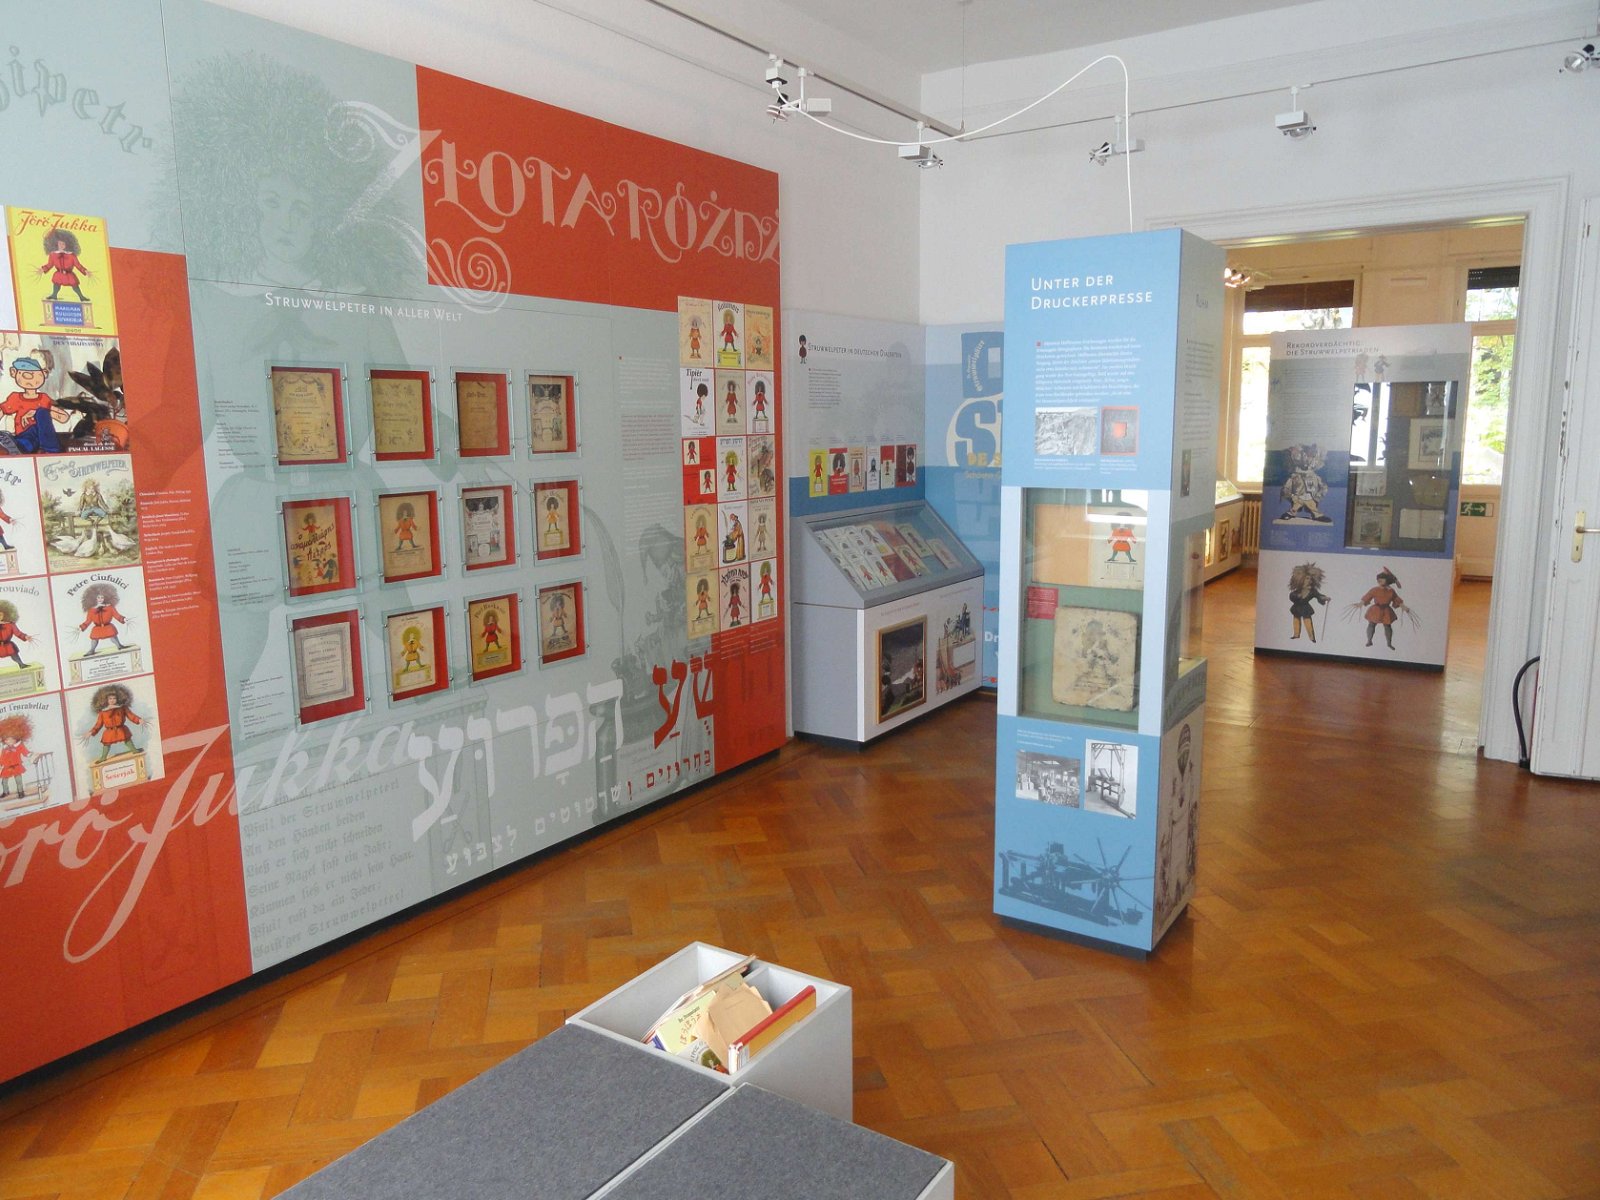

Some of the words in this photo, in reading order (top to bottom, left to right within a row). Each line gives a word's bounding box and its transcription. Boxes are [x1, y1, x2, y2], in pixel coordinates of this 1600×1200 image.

[17, 209, 50, 236] Jörö
[47, 213, 97, 234] Jukka
[1031, 278, 1079, 291] UNTER
[1086, 275, 1113, 288] DER
[265, 292, 375, 314] STRUWWELPETER
[380, 306, 393, 316] IN
[397, 308, 430, 319] ALLER
[433, 308, 463, 322] WELT
[1031, 291, 1153, 309] DRUCKERPRESSE
[67, 578, 89, 596] Petre
[90, 574, 130, 589] Ciufulici
